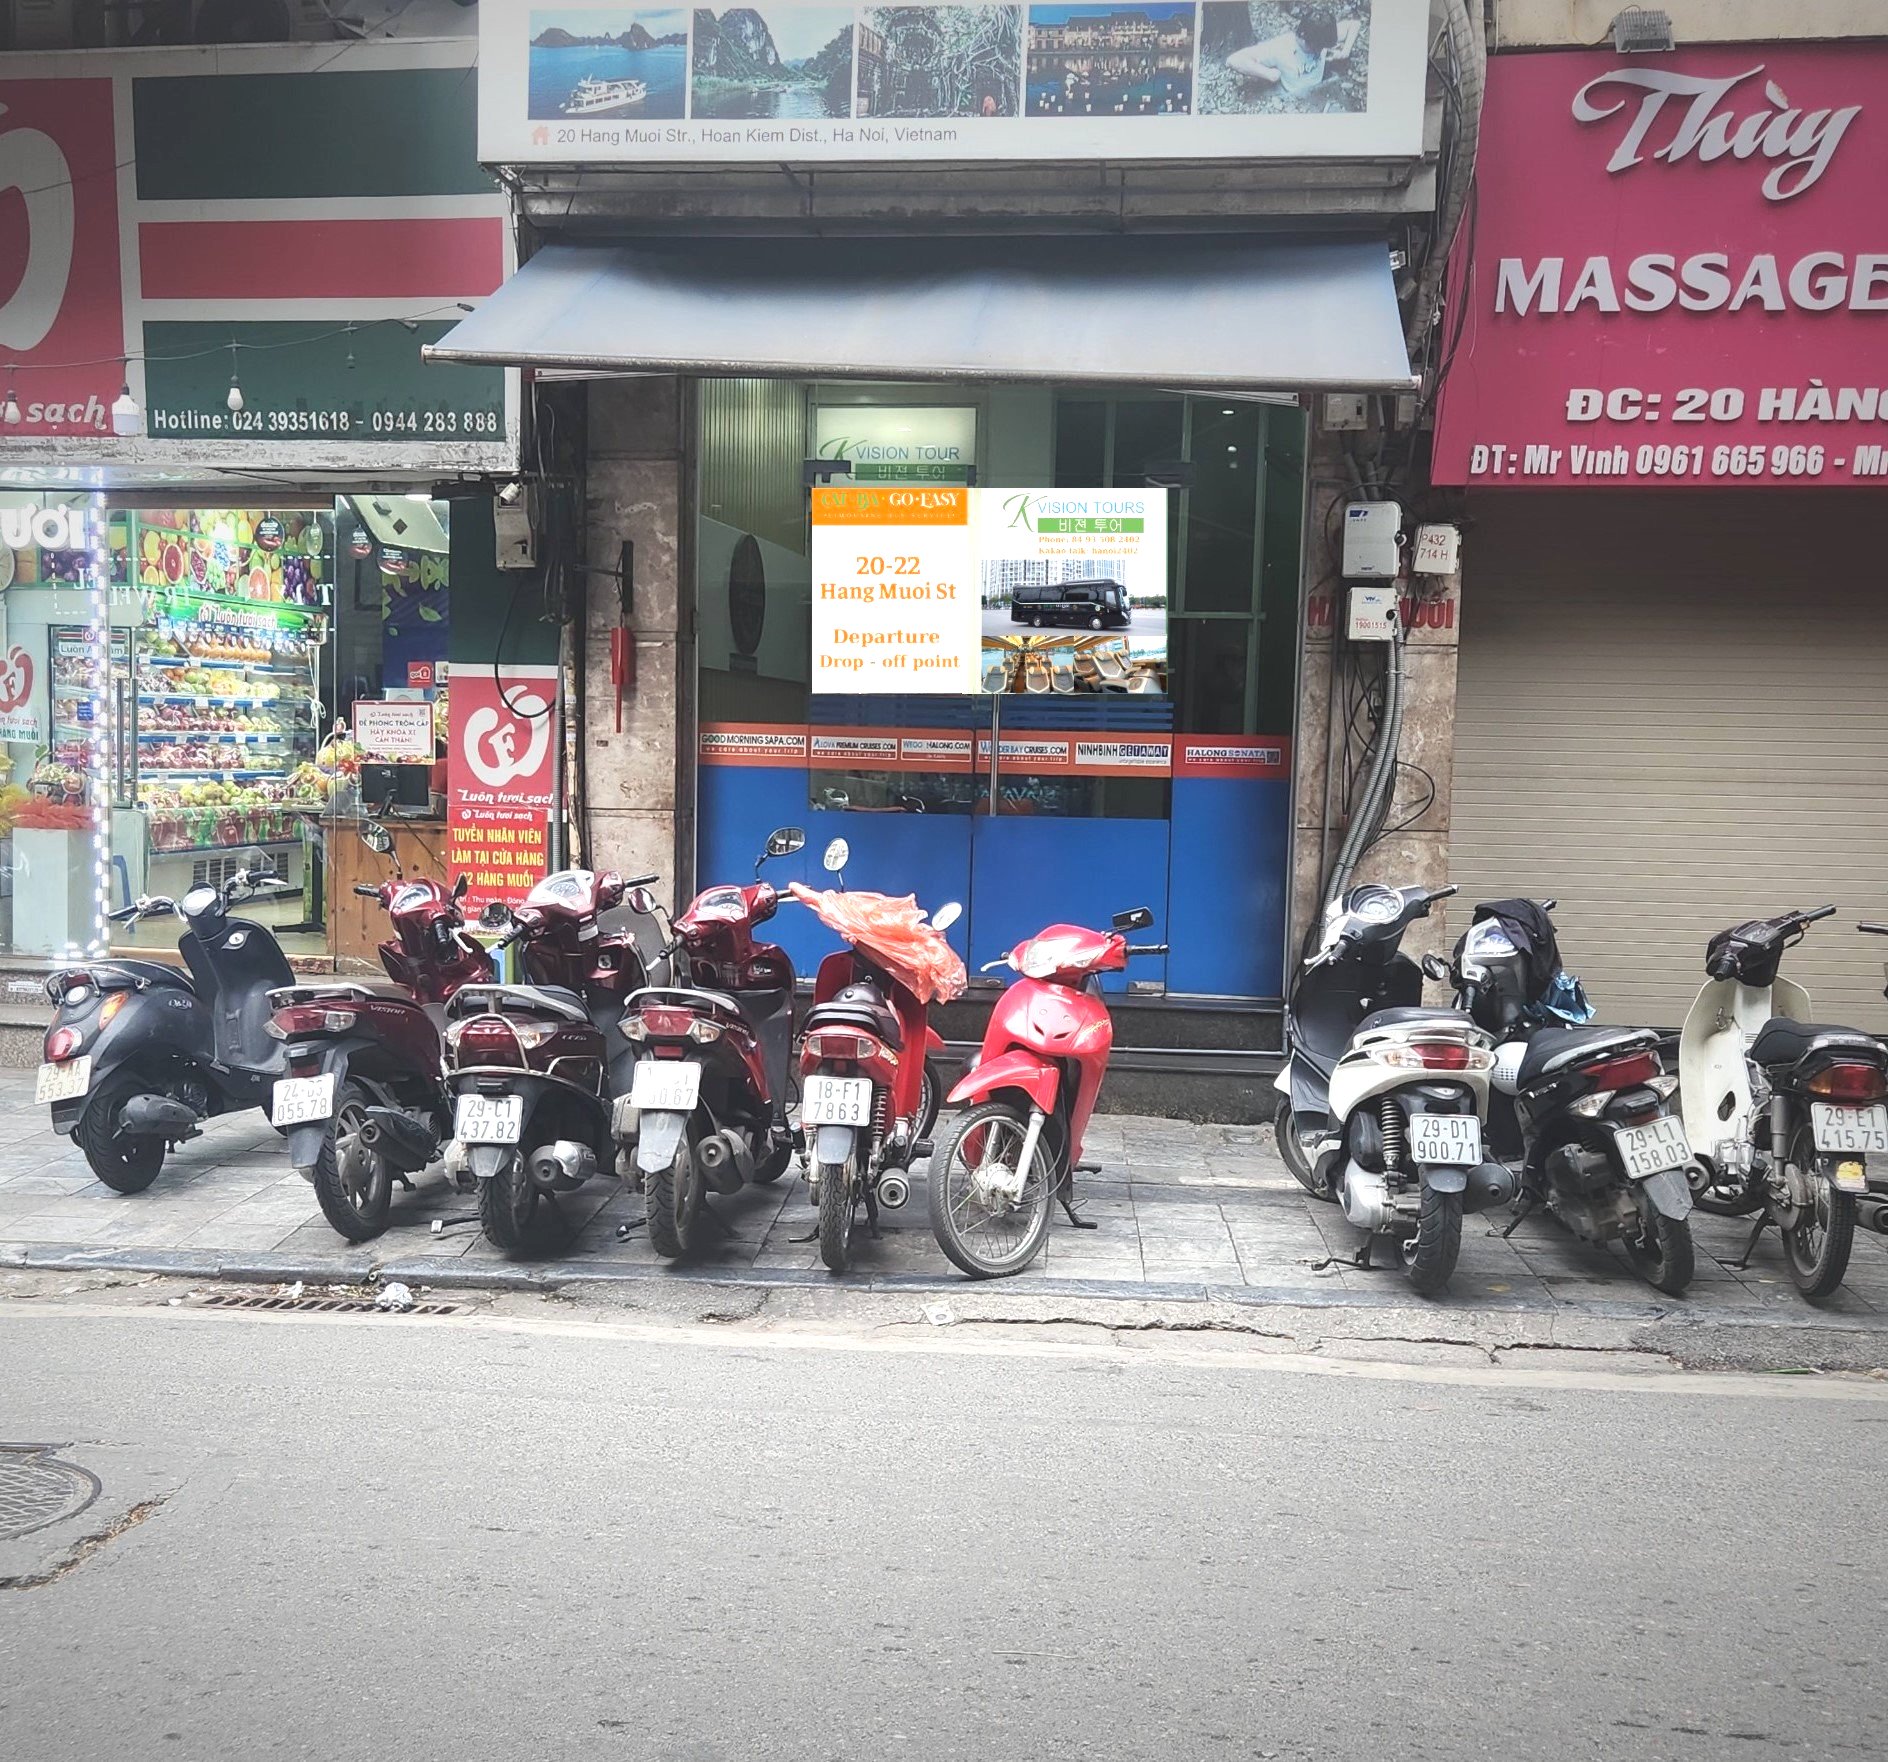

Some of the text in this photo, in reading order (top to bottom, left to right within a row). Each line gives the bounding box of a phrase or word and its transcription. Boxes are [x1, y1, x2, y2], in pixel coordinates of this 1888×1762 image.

[557, 126, 957, 145] 20 Hang Muoi Str., Hoan Kiem Dist., Ha Noi, Vietnam
[1572, 64, 1863, 201] Thùy
[1494, 251, 1888, 318] MASSAGE
[1566, 378, 1888, 421] ĐC: 20 HÀN
[154, 408, 229, 430] Hotline:
[232, 410, 264, 431] 024
[268, 410, 349, 431] 39351618
[372, 411, 418, 432] 0944
[423, 411, 457, 432] 283
[463, 412, 497, 433] 888
[855, 446, 909, 460] VISION
[915, 446, 961, 460] TOUR
[1470, 444, 1518, 475] ĐT:
[1523, 444, 1562, 475] Mr
[1635, 444, 1704, 476] 0961
[1711, 444, 1767, 476] 665
[1770, 444, 1825, 476] 966
[1002, 492, 1145, 532] K VISION TOURS
[1094, 518, 1123, 533] 투어
[1440, 549, 1448, 560] H
[856, 556, 921, 575] 20-22
[820, 582, 957, 603] Hang Muoi St
[1355, 621, 1387, 629] 19001515
[833, 629, 940, 648] Departure
[820, 654, 864, 671] Drop
[882, 654, 908, 668] off
[913, 654, 960, 671] point
[726, 735, 764, 744] MORNING
[487, 828, 515, 844] NHÂN
[451, 847, 472, 864] LÀM
[515, 850, 544, 866] HÀNG
[476, 870, 504, 887] HÀNG
[277, 1098, 328, 1122] 055.78
[814, 1101, 860, 1121] 7863
[460, 1121, 516, 1140] 437.82
[1625, 1121, 1676, 1152] 29-L1
[1821, 1129, 1885, 1150] 415.75
[1417, 1142, 1476, 1162] 900.71
[1629, 1141, 1689, 1174] 158.03
